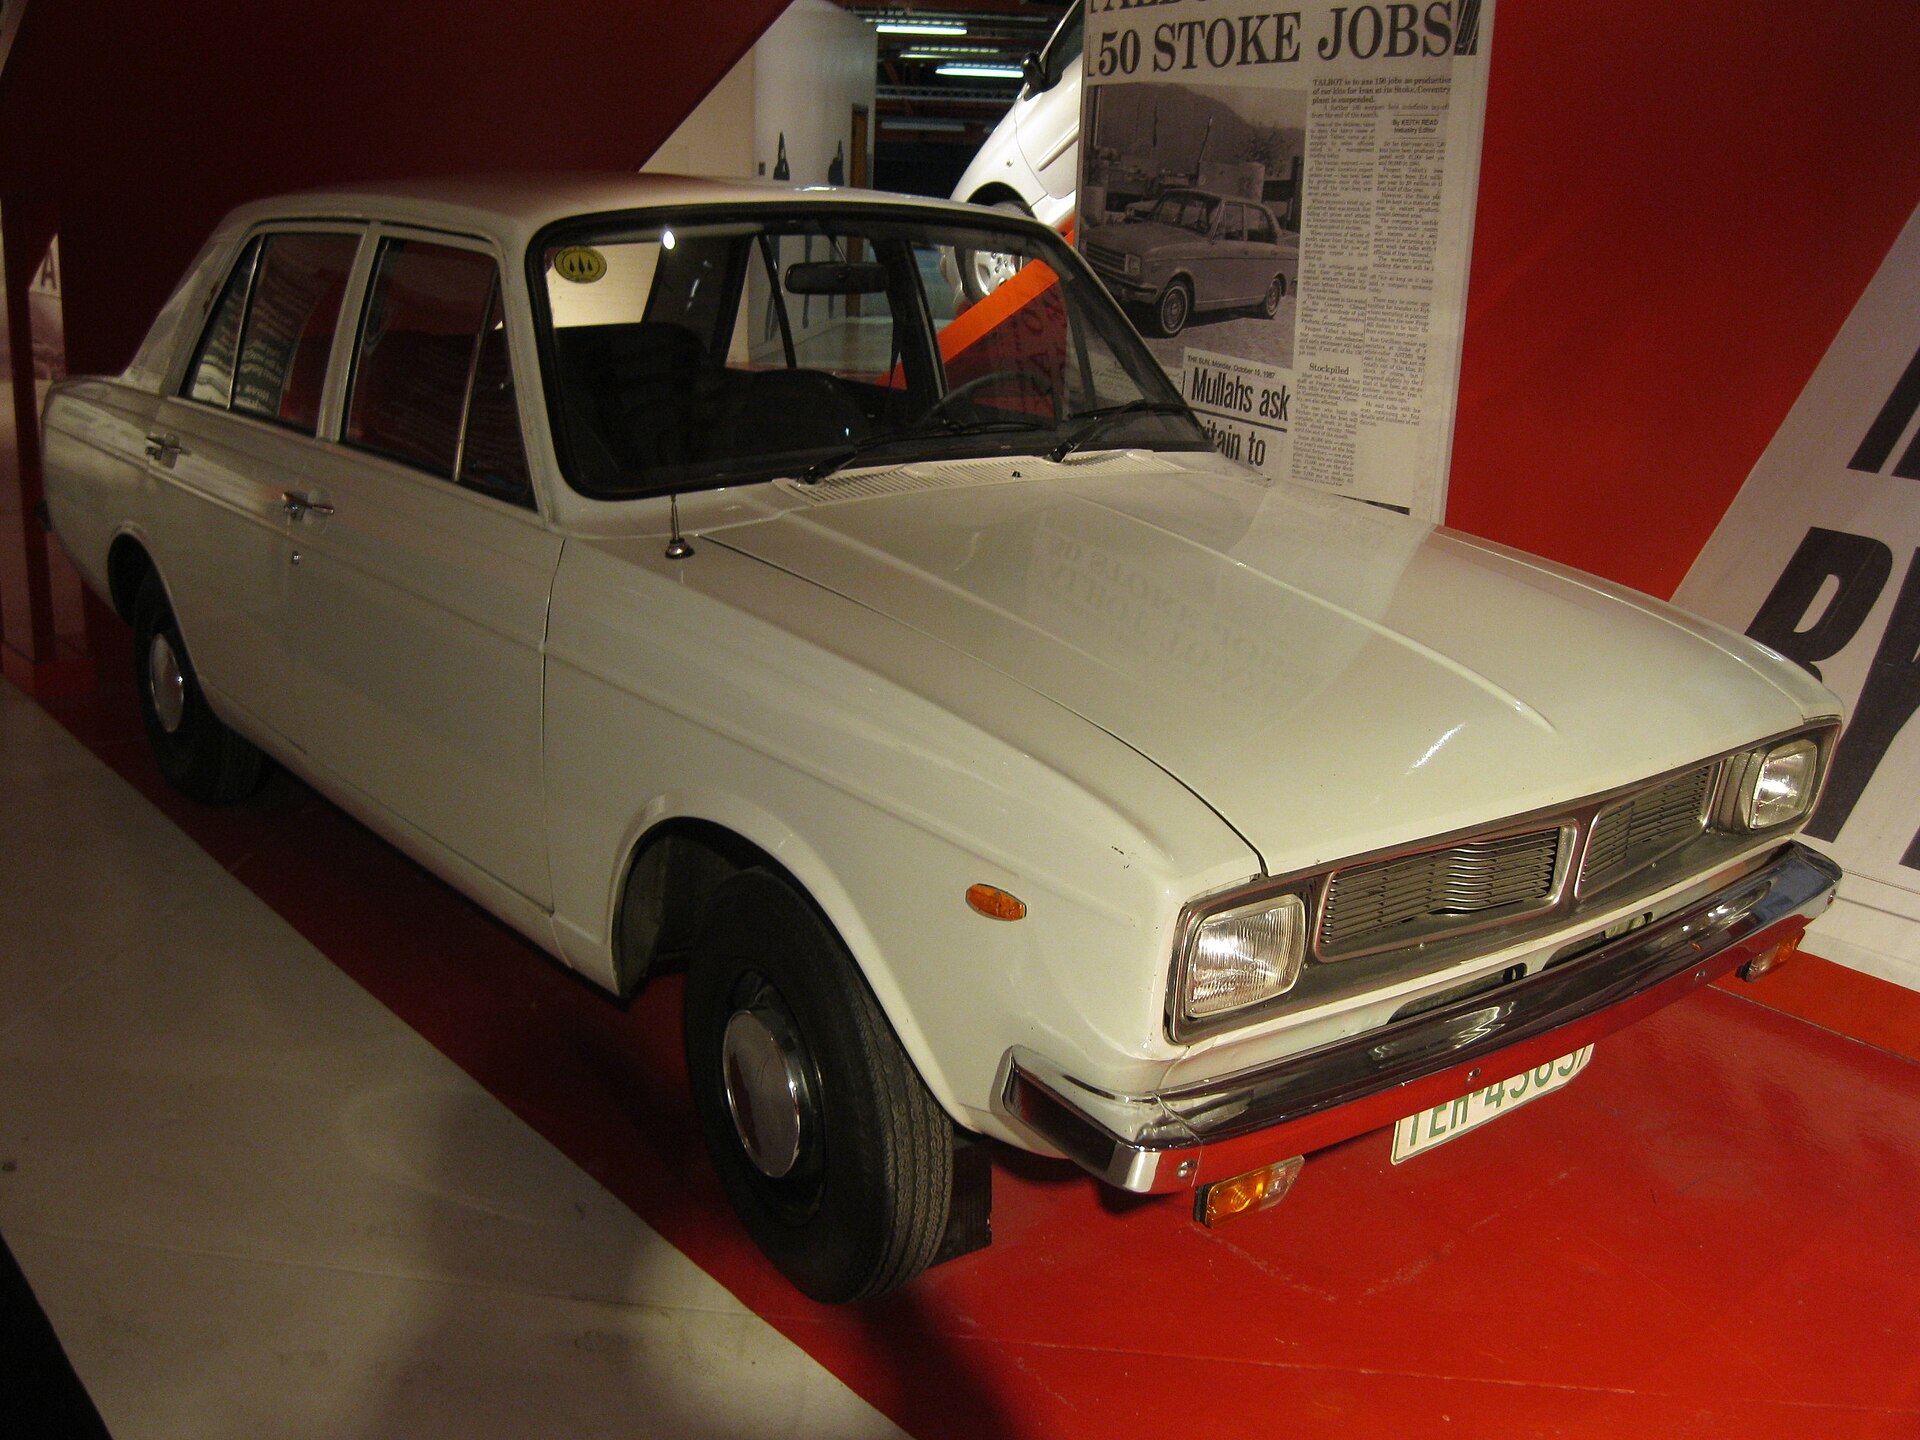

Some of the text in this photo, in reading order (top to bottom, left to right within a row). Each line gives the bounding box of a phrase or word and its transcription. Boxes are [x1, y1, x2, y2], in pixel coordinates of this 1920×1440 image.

[1153, 12, 1301, 73] STOKE
[1318, 1, 1452, 61] JOBS
[1313, 78, 1343, 86] TALBOT
[1388, 77, 1402, 86] jobs
[1418, 86, 1451, 95] Coventry
[1188, 355, 1197, 363] THE
[1199, 357, 1210, 366] SUN,
[1212, 360, 1232, 371] Monday,
[1233, 364, 1253, 375] October
[1263, 371, 1276, 379] 1987
[1309, 362, 1349, 375] Stockpiled
[1191, 367, 1253, 413] Mullahs
[1259, 385, 1291, 422] ask
[1248, 431, 1266, 466] to
